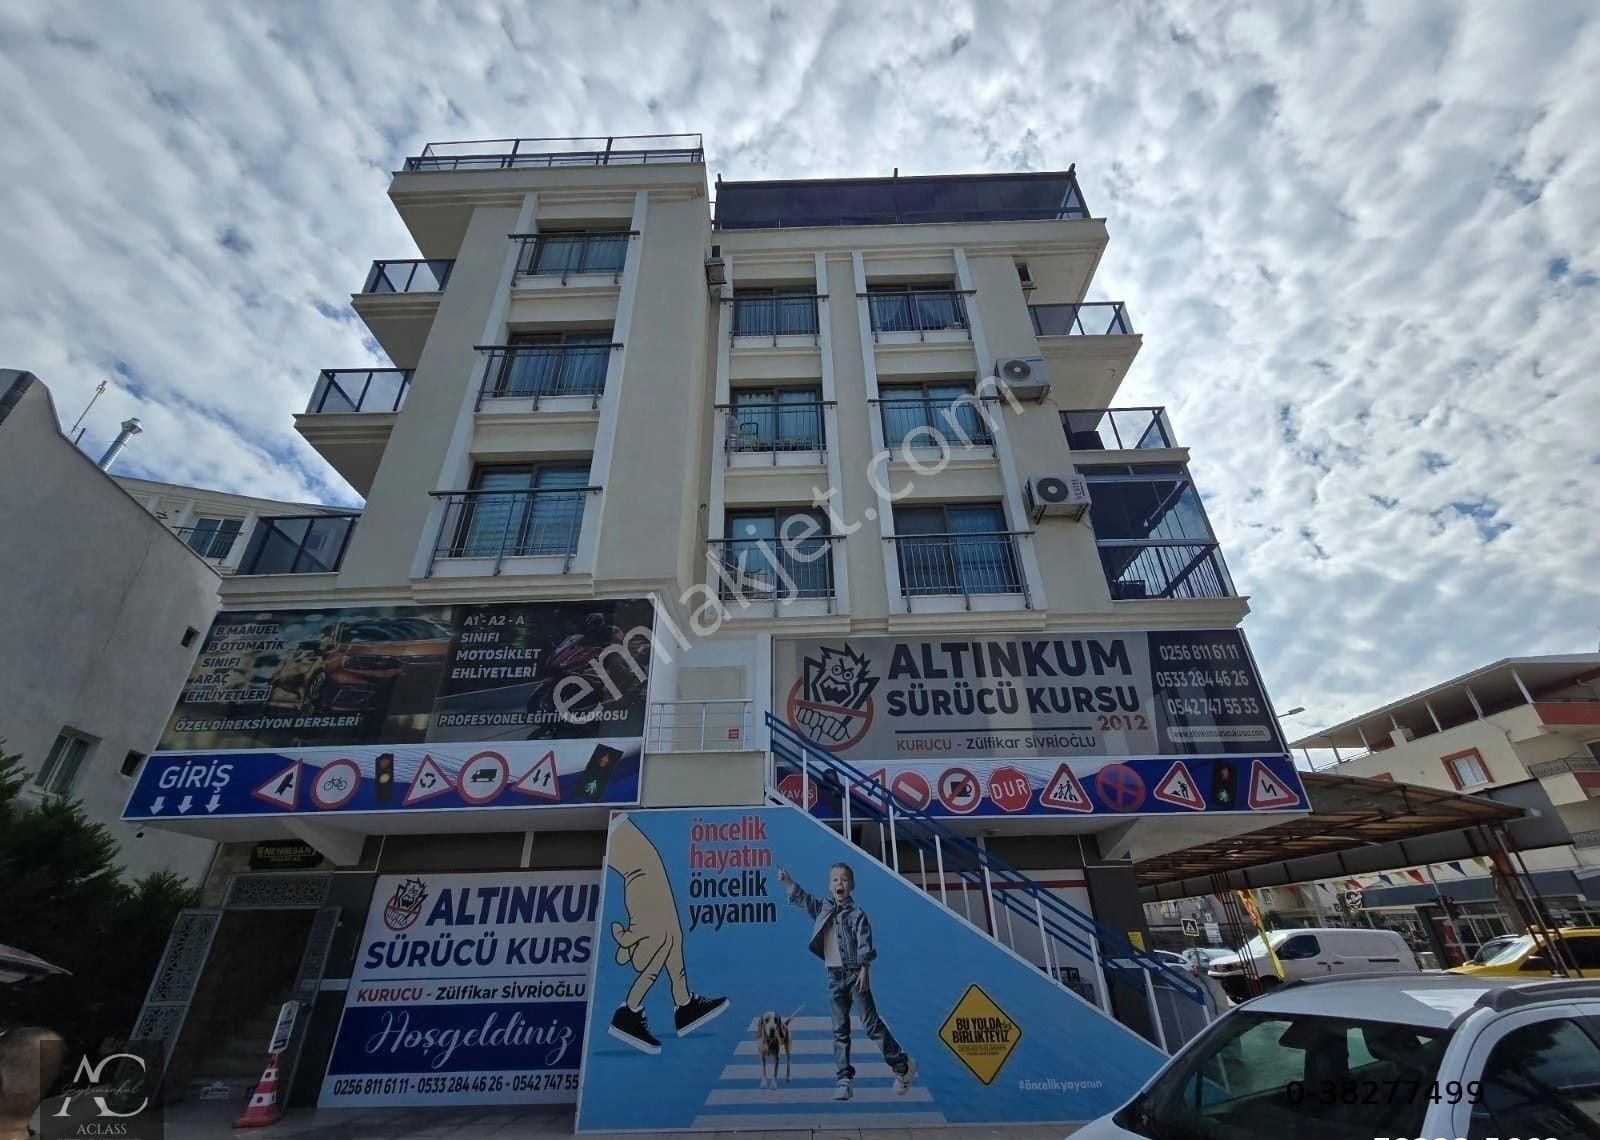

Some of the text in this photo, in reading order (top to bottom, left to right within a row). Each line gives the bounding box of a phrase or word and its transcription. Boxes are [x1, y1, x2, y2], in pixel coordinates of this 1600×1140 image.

[464, 616, 478, 626] A1
[488, 616, 506, 626] A2
[515, 615, 525, 625] A
[227, 624, 280, 636] MANUEL
[461, 632, 500, 643] SINIFI
[221, 639, 287, 651] OTOMATİK
[1160, 644, 1240, 660] 0256 811 61 11
[202, 657, 241, 668] SINIFI
[456, 647, 541, 661] MOTOSİKLET
[888, 639, 1132, 679] ALTINKUM
[194, 673, 230, 685] ARAÇ
[451, 664, 537, 679] EHLİYETLERİ
[1156, 670, 1249, 687] 0533 284 46 26
[185, 686, 272, 701] EHLİYETLERİ
[887, 681, 1140, 716] SÜRÜCÜ KURSU
[1168, 697, 1259, 715] 0542 747 55 33
[176, 714, 360, 731] ÖZEL DİREKSİYON DERSLERİ
[438, 709, 629, 726] PROFESYONEL EĞİTİM KADROSU
[1097, 714, 1148, 731] 2012
[896, 739, 951, 751] KURUCU
[966, 737, 1020, 750] Zülfikar
[1025, 733, 1096, 749] SİVRİOĞLU
[158, 760, 234, 793] GİRİŞ
[991, 778, 1028, 798] DUR
[691, 816, 767, 842] öncelik
[690, 843, 772, 874] hayatın
[689, 870, 768, 898] öncelik
[689, 902, 777, 932] yayanın
[364, 931, 497, 969] SÜRÜCÜ
[356, 987, 423, 1002] KURUCU
[436, 985, 498, 1000] Zülfikar
[502, 981, 585, 998] SİVRİOĞLU
[956, 1017, 1002, 1030] BU YOLDA
[366, 1010, 576, 1069] Hoşgeldiniz
[334, 1079, 362, 1095] 0256
[364, 1079, 382, 1094] 811
[383, 1079, 396, 1094] 61
[398, 1078, 408, 1093] 11
[418, 1078, 446, 1093] 0533
[447, 1077, 469, 1092] 284
[472, 1076, 486, 1092] 46
[487, 1076, 503, 1091] 26
[512, 1075, 541, 1091] 0542
[544, 1074, 562, 1090] 747
[563, 1074, 579, 1090] 55
[1019, 1078, 1103, 1092] #öncelikyayanın
